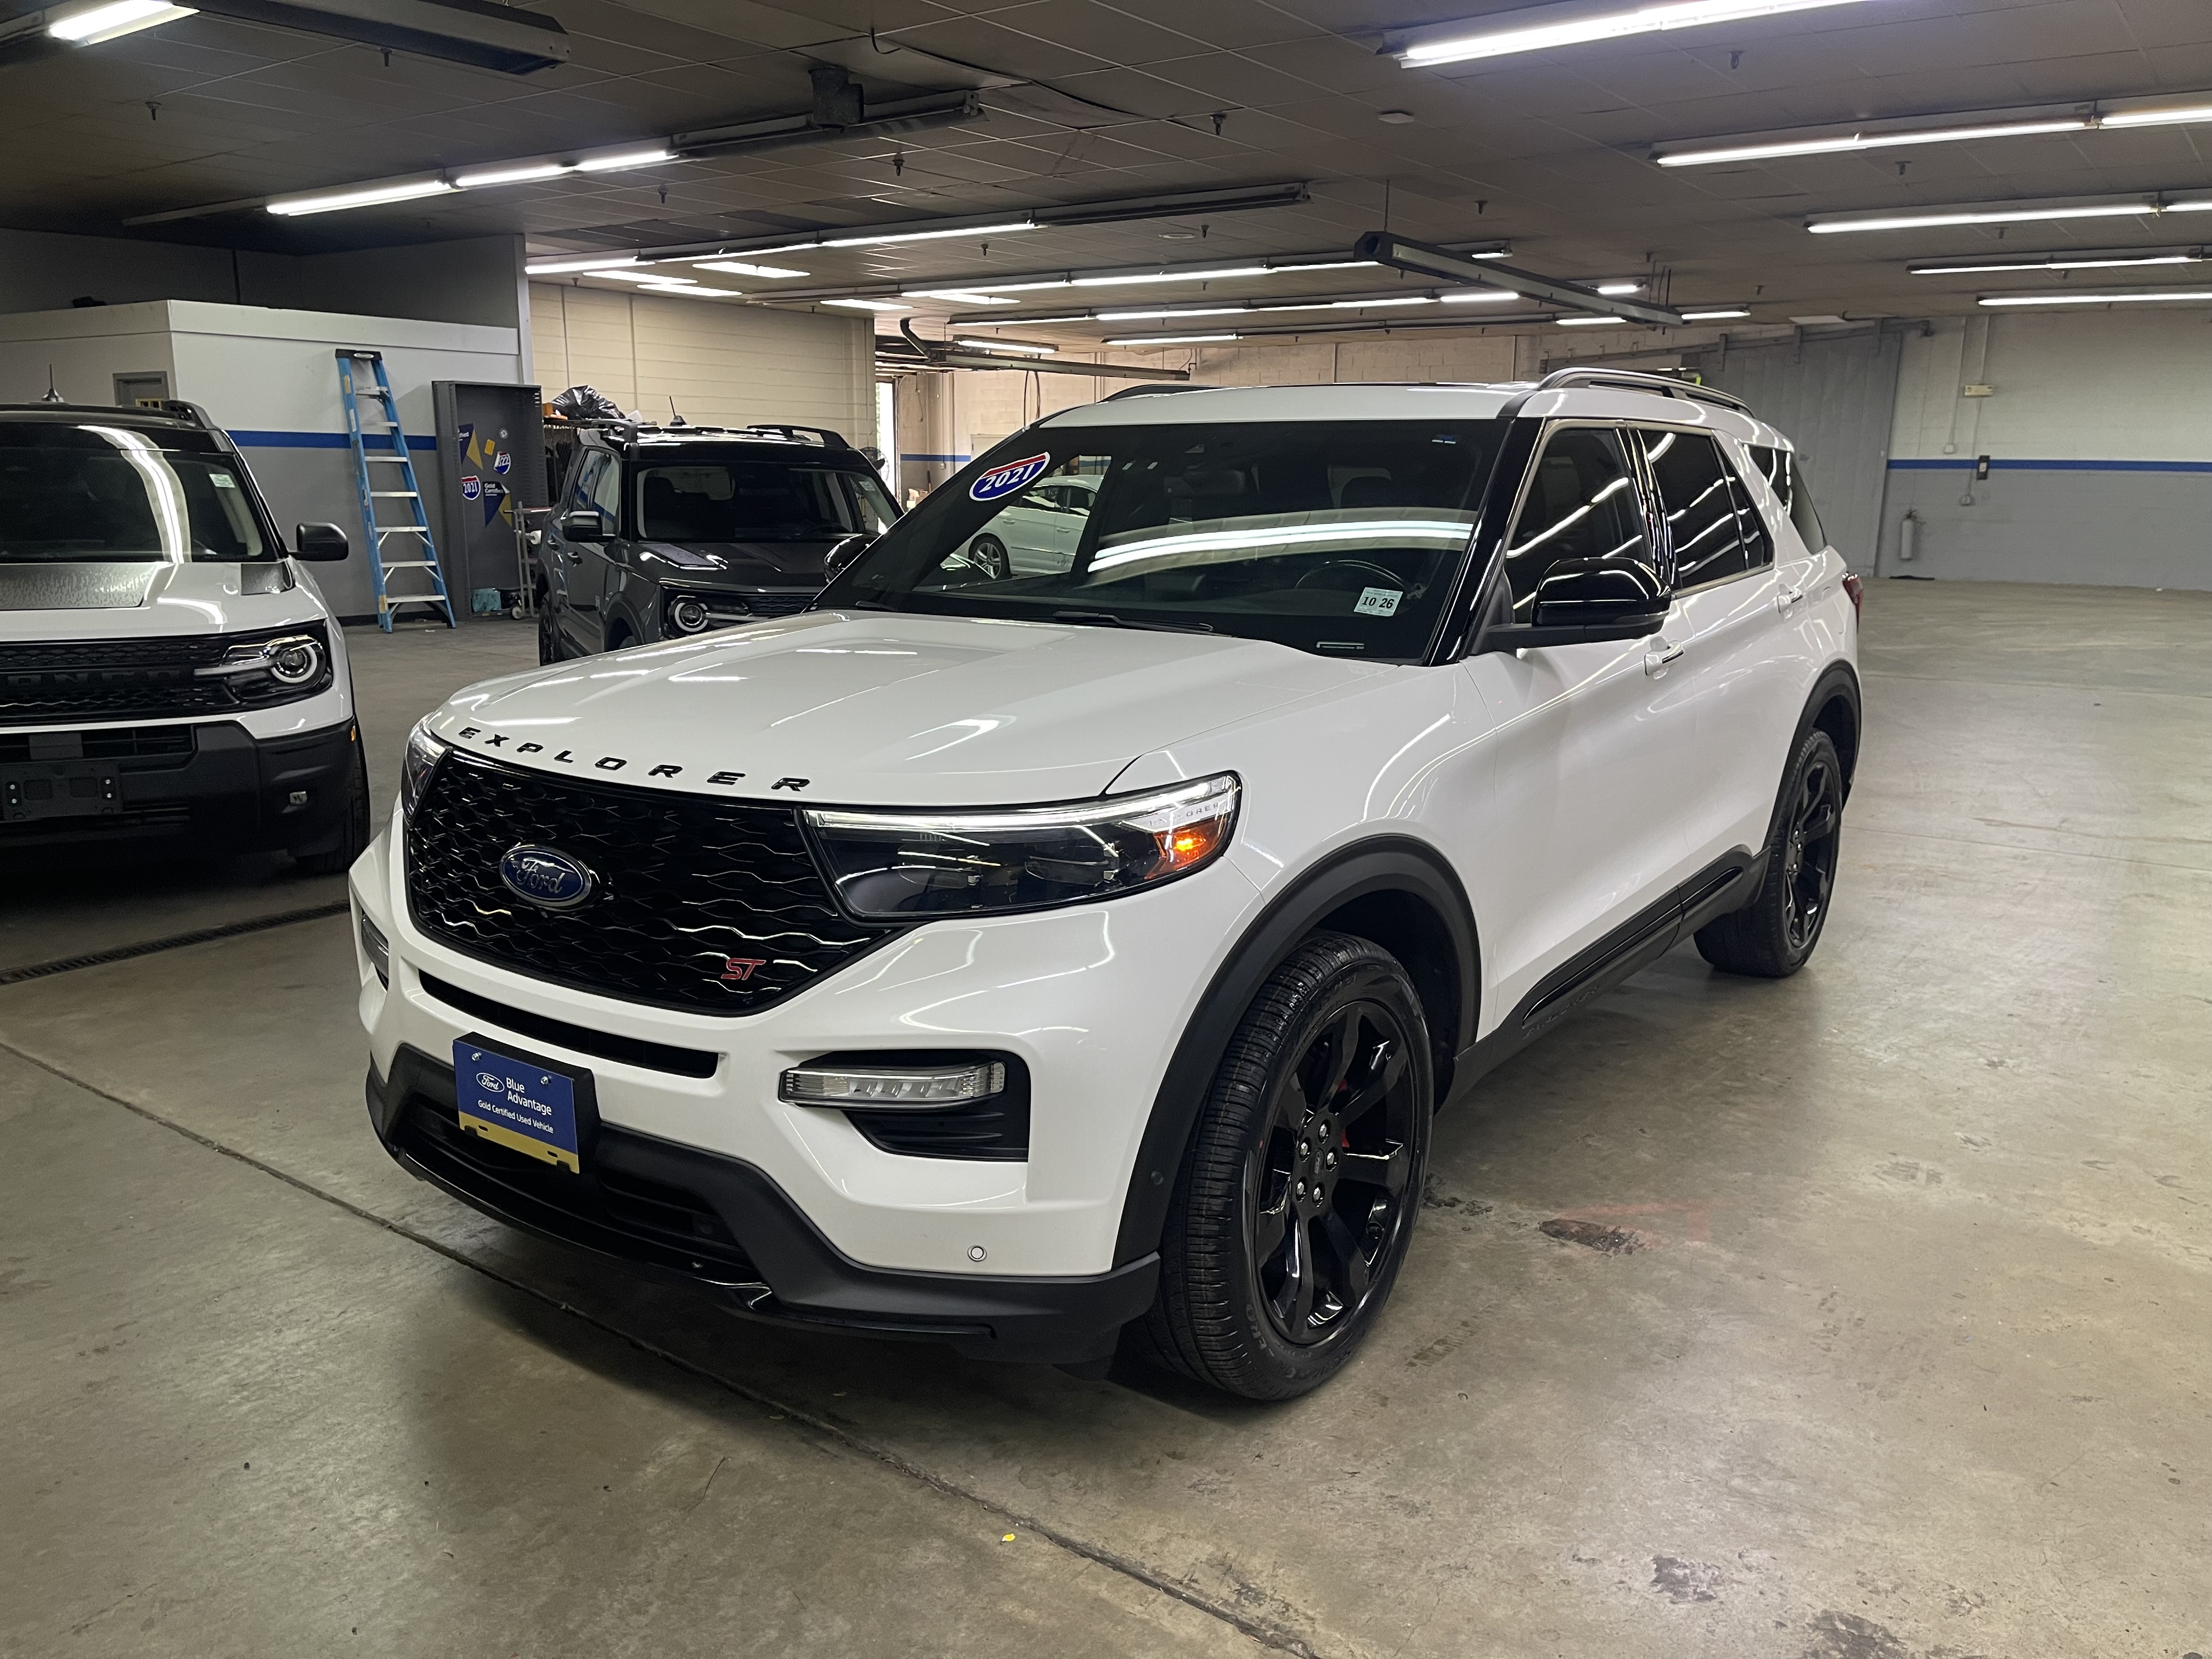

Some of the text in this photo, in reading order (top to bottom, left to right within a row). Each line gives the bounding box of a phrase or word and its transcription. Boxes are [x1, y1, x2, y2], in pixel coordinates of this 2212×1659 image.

[463, 482, 478, 494] 2021
[978, 464, 1035, 493] 2021
[1362, 596, 1395, 609] 10 26
[458, 726, 810, 792] EXPLORER
[720, 957, 767, 981] ST
[481, 1073, 500, 1091] Ford
[506, 1077, 525, 1093] Blue
[507, 1091, 552, 1116] Advantage
[478, 1099, 554, 1134] Gold Certified Used Vehicle
